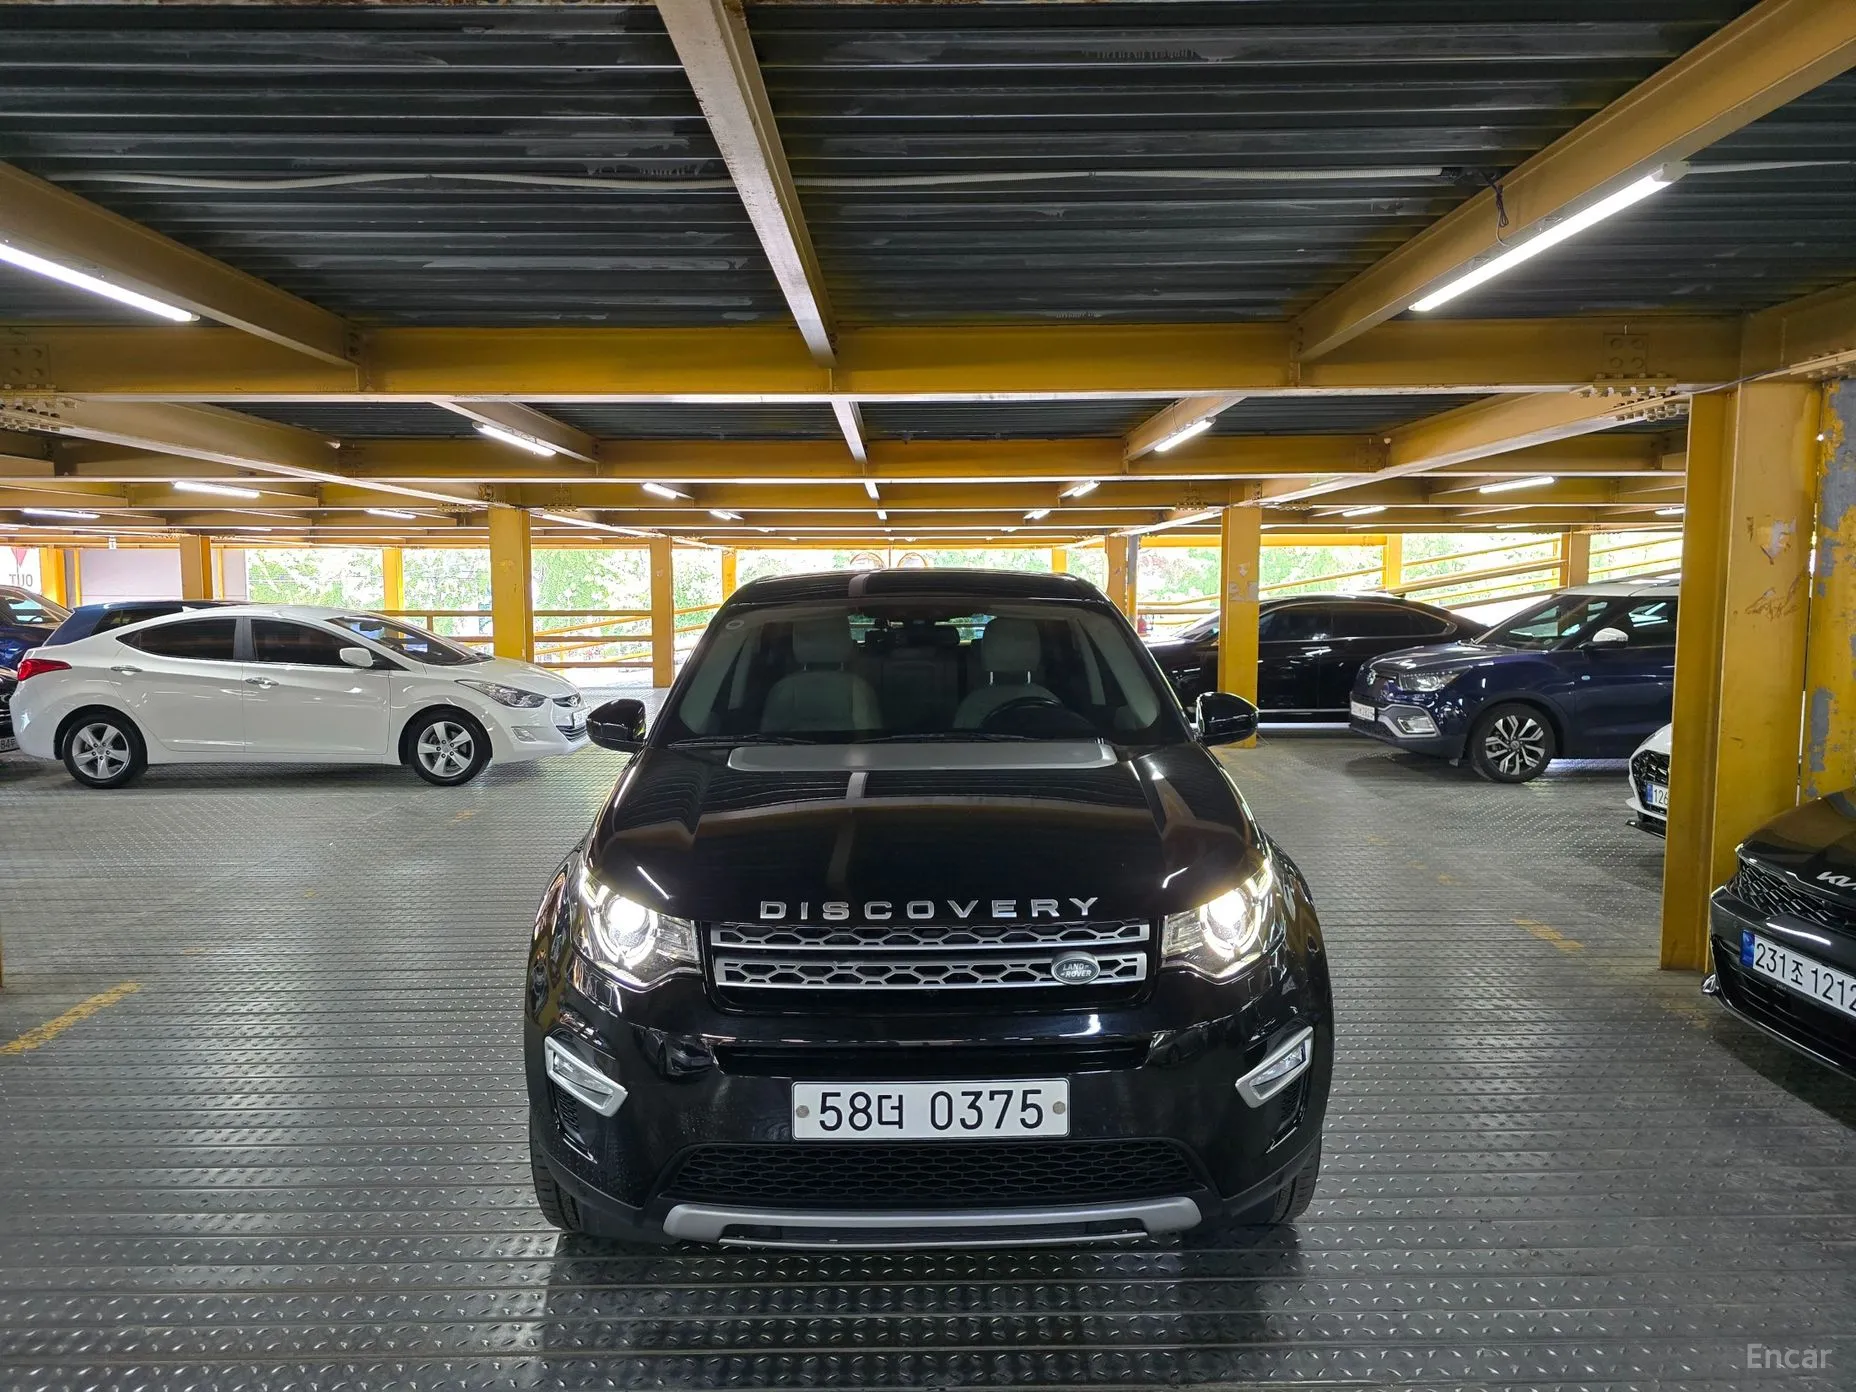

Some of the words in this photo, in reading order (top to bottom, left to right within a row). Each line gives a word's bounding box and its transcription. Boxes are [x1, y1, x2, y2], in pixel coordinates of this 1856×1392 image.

[759, 896, 1098, 921] DISCOVERY
[1062, 963, 1085, 971] LAND
[1065, 969, 1092, 978] ROVER
[1755, 942, 1804, 987] 231조
[819, 1091, 904, 1132] 58더
[930, 1089, 1044, 1131] 0375
